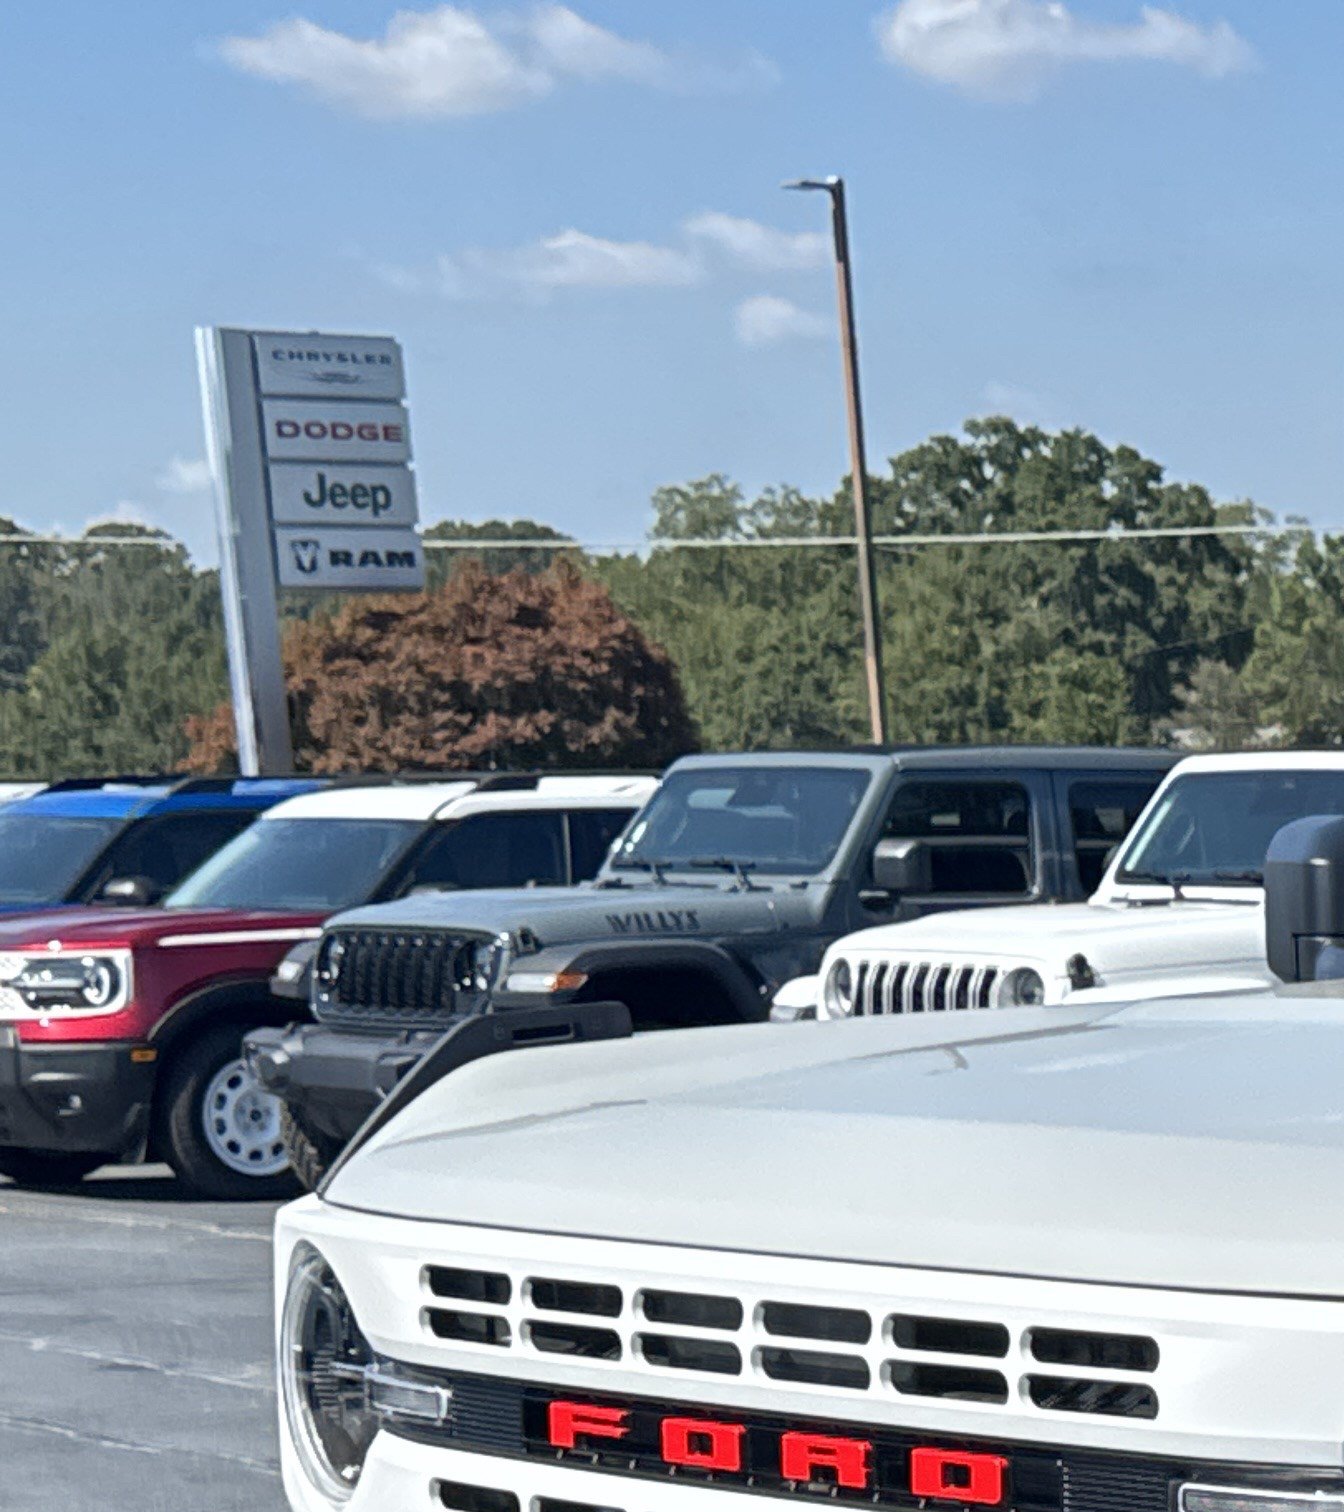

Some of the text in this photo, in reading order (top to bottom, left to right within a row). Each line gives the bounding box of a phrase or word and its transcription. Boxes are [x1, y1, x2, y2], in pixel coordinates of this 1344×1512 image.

[272, 350, 392, 365] CHRYSLER
[275, 421, 402, 443] DODGE
[303, 472, 392, 516] Jeep
[330, 549, 416, 568] RAM
[605, 909, 700, 932] WILLYS
[548, 1401, 1008, 1504] FORD
